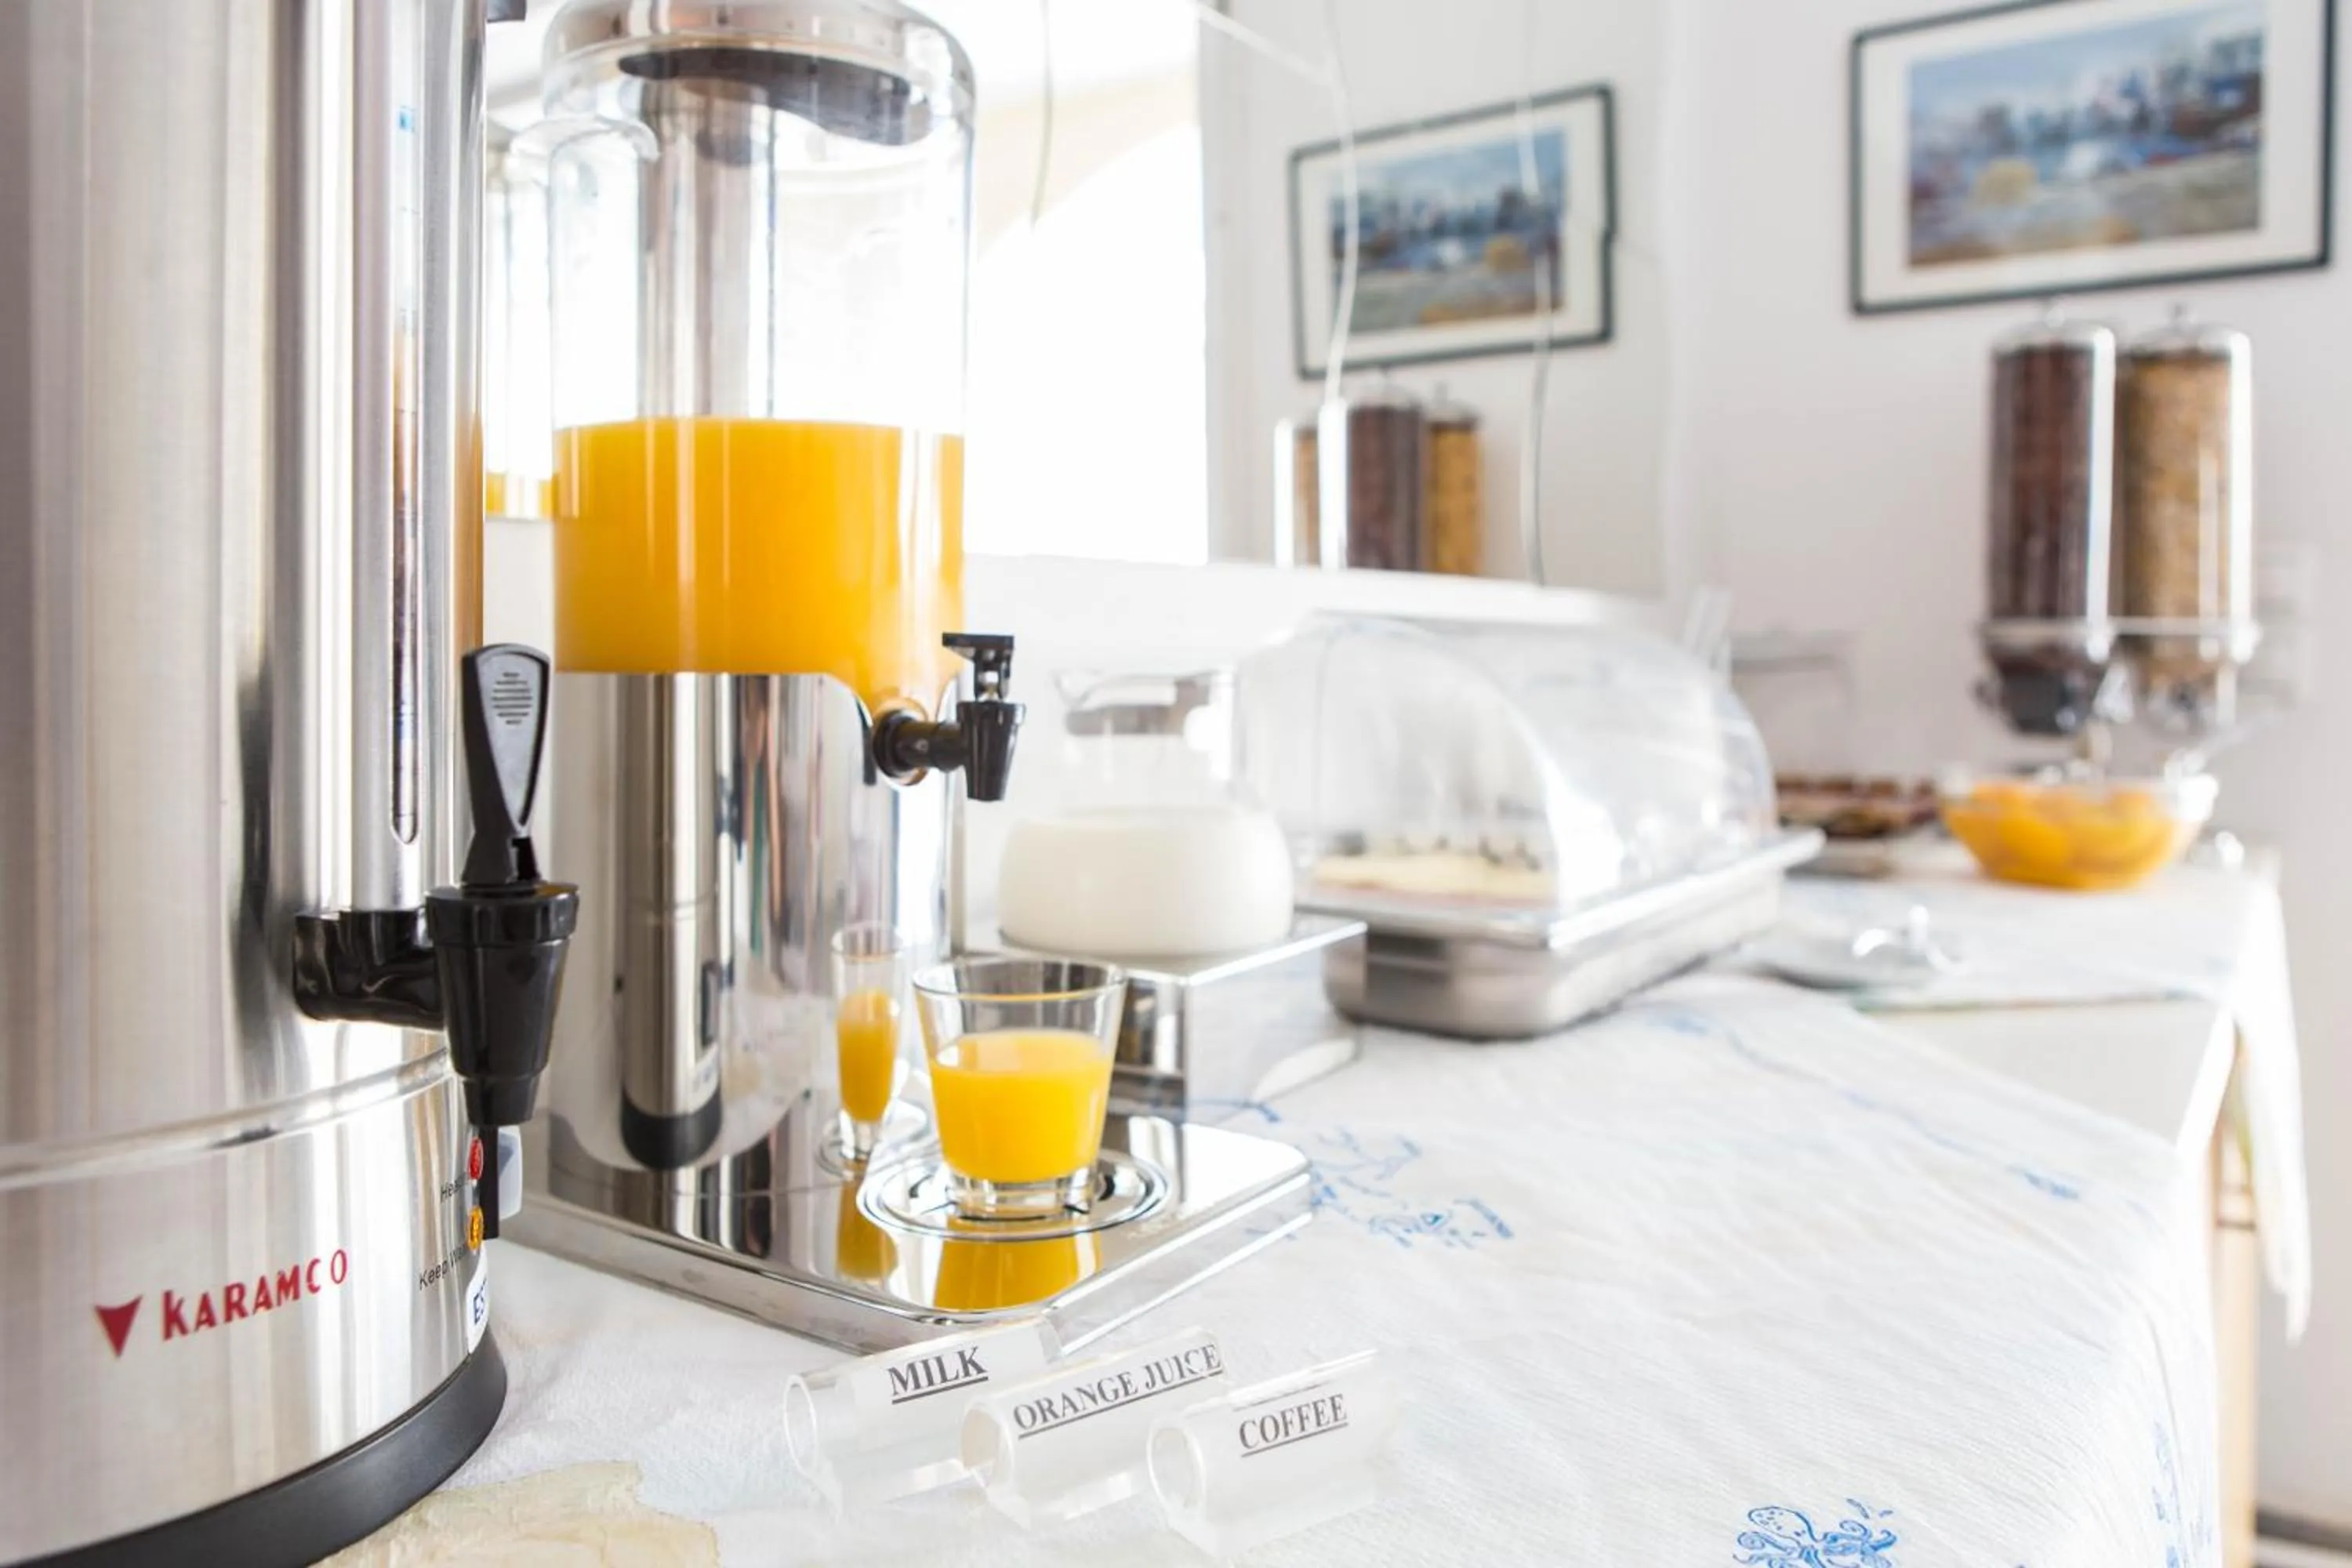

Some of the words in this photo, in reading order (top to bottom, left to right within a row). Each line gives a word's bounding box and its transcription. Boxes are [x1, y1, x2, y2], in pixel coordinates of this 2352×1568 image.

[162, 1249, 347, 1341] KARAMCO
[419, 1260, 448, 1291] Keep
[887, 1345, 989, 1396] MILK
[1013, 1371, 1138, 1430] ORANGE
[1142, 1344, 1221, 1391] JUICE
[1239, 1393, 1348, 1450] COFFEE
